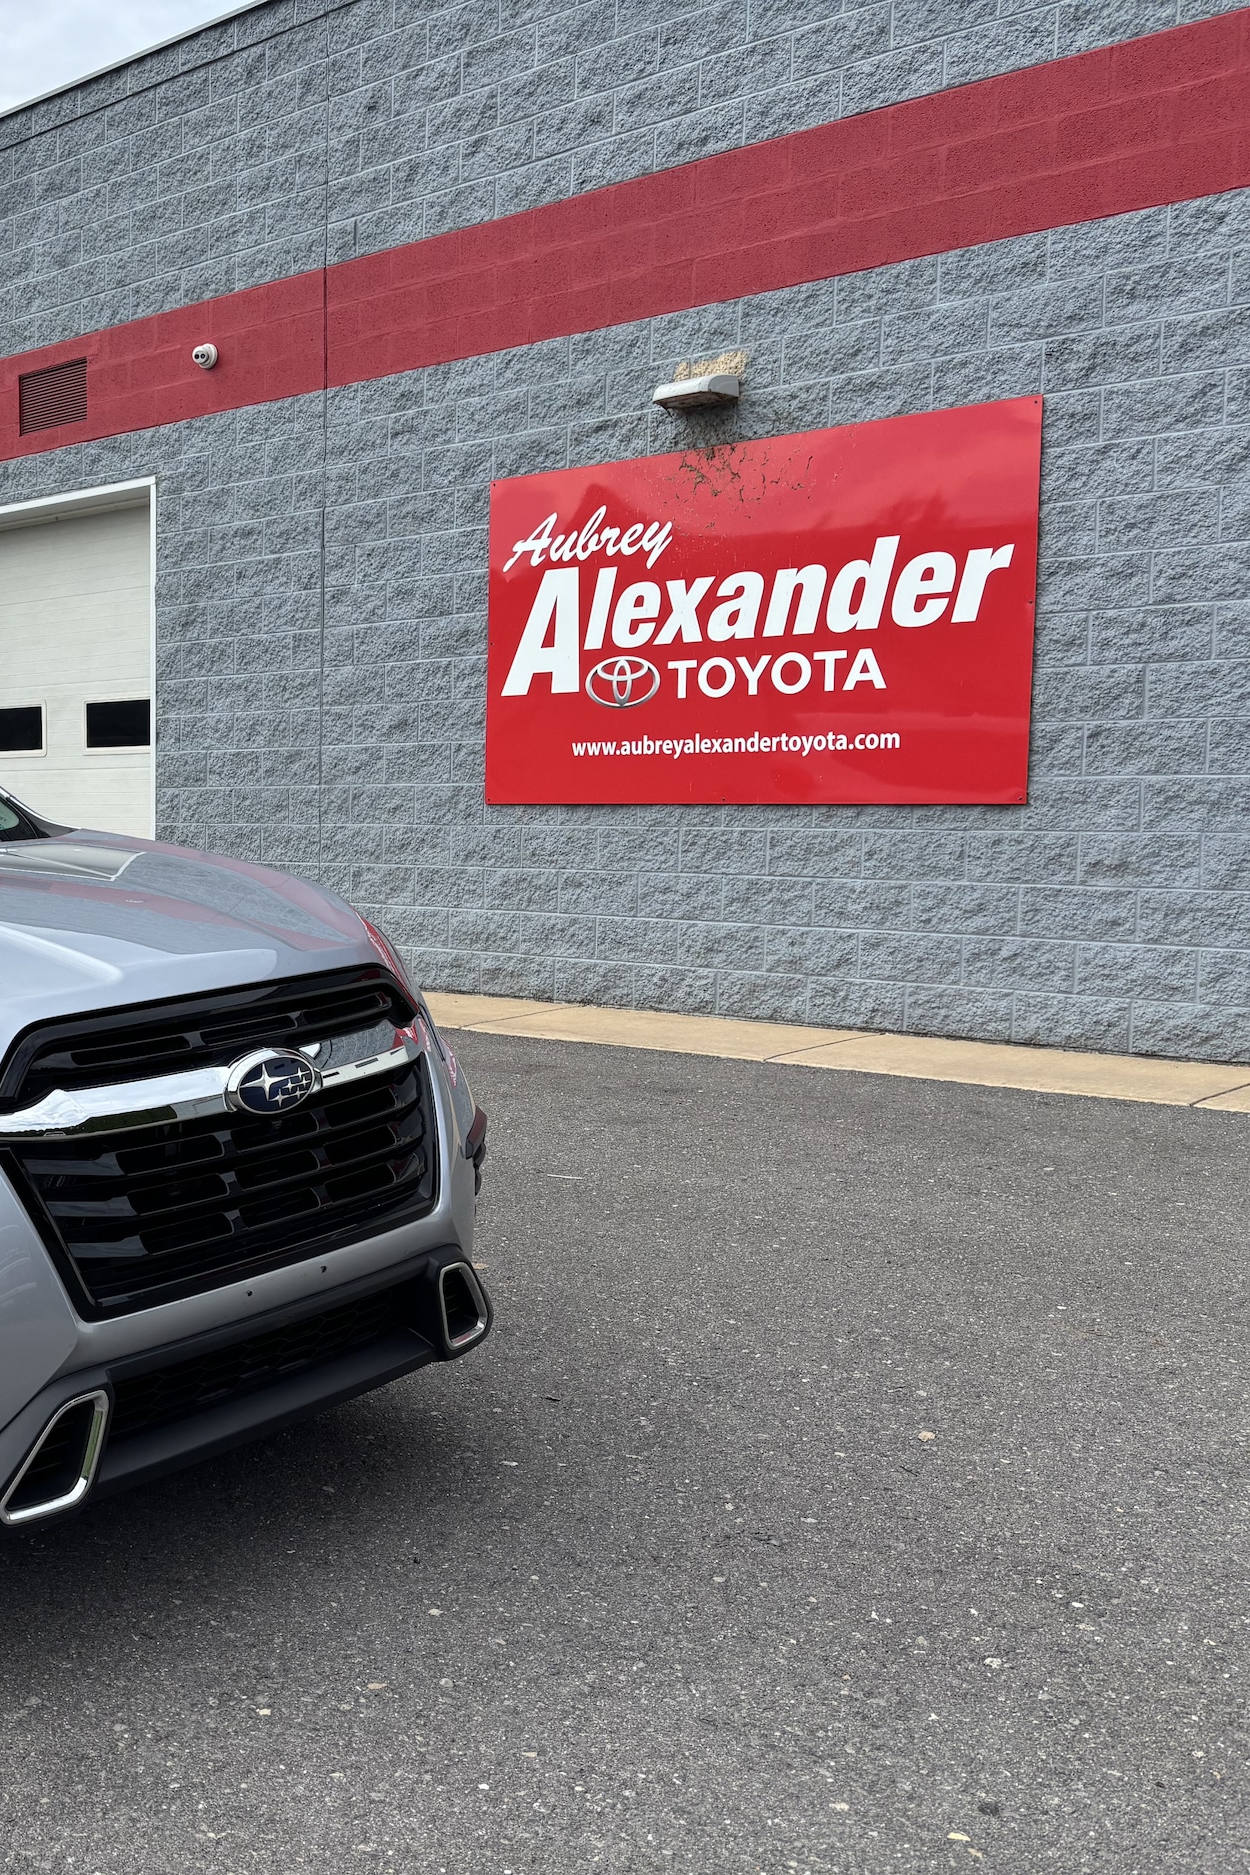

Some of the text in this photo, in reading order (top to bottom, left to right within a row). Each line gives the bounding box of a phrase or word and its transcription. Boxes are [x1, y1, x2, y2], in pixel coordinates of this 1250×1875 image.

[502, 505, 673, 573] Aubrey
[500, 535, 1015, 697] Alexander
[667, 648, 887, 699] TOYOTA
[571, 731, 901, 760] www.aubreyalexandertoyota.com
